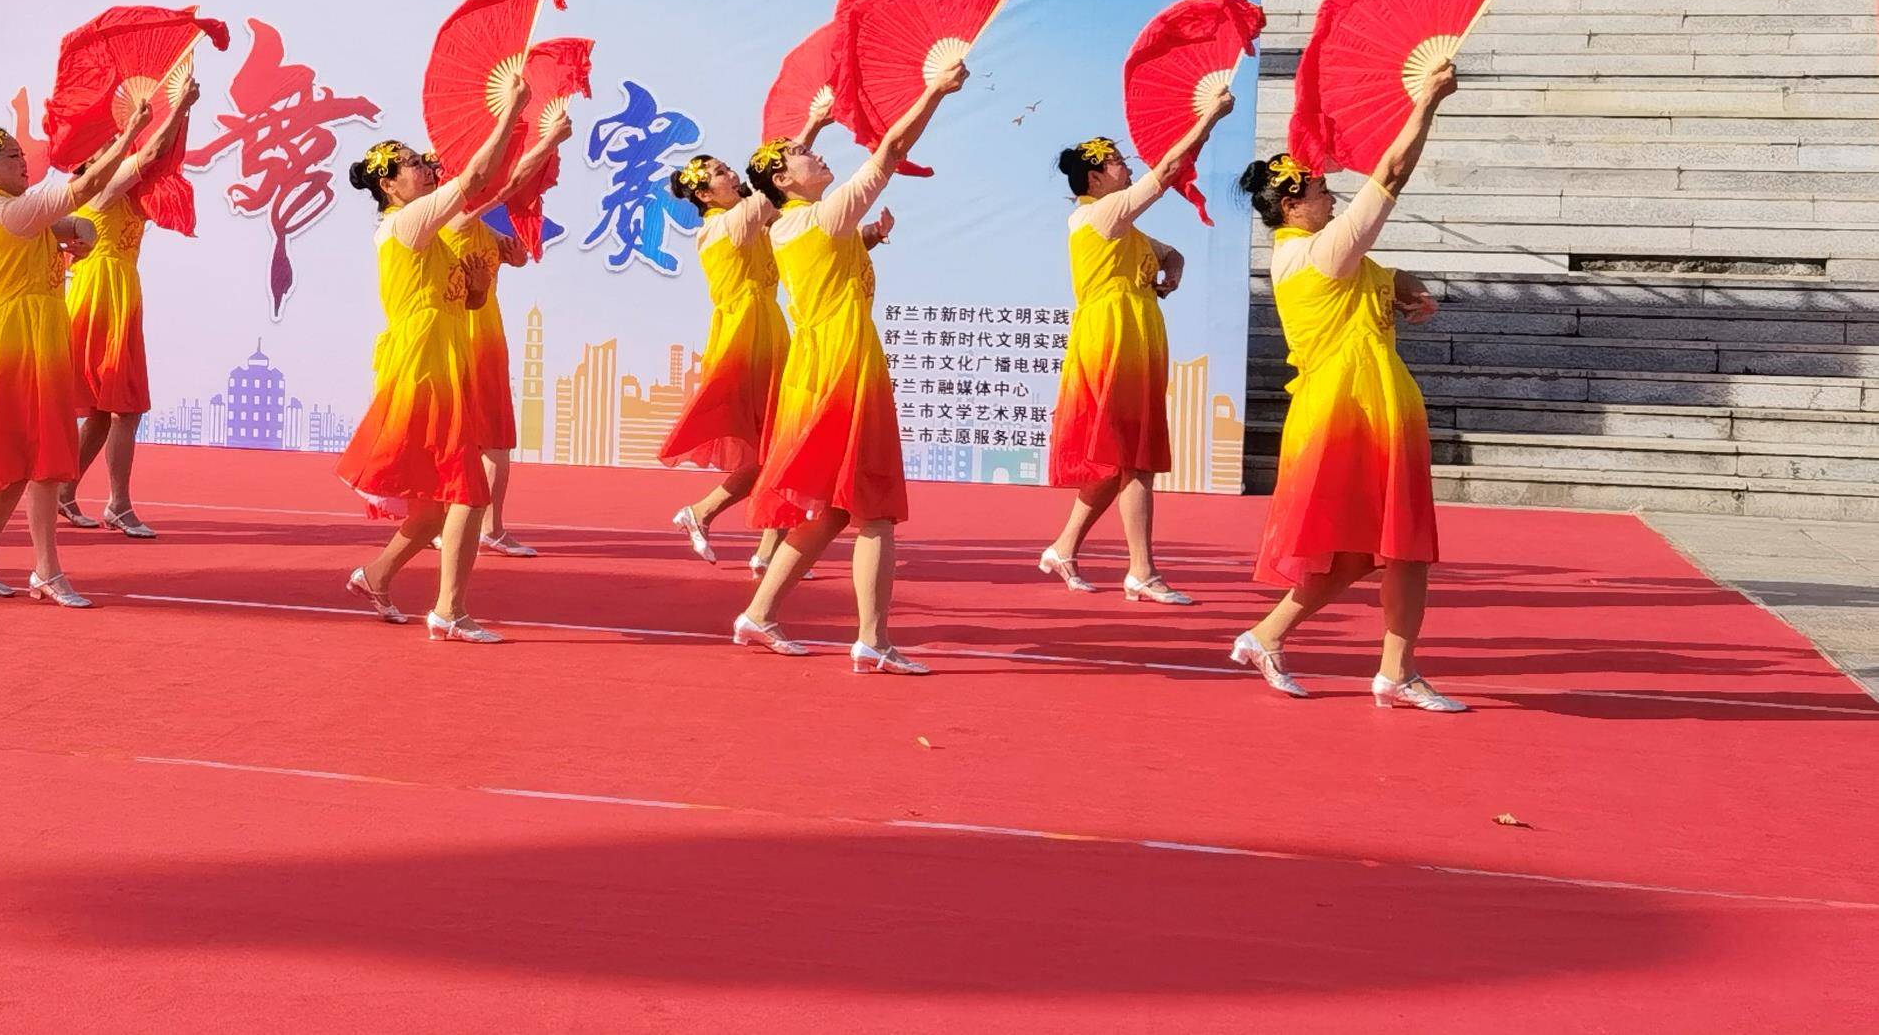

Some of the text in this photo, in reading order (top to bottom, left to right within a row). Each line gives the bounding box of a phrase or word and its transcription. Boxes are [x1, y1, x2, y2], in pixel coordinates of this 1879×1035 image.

[885, 304, 1071, 326] 舒兰市新时代文明实践
[894, 402, 1056, 423] 兰市文学艺术界联
